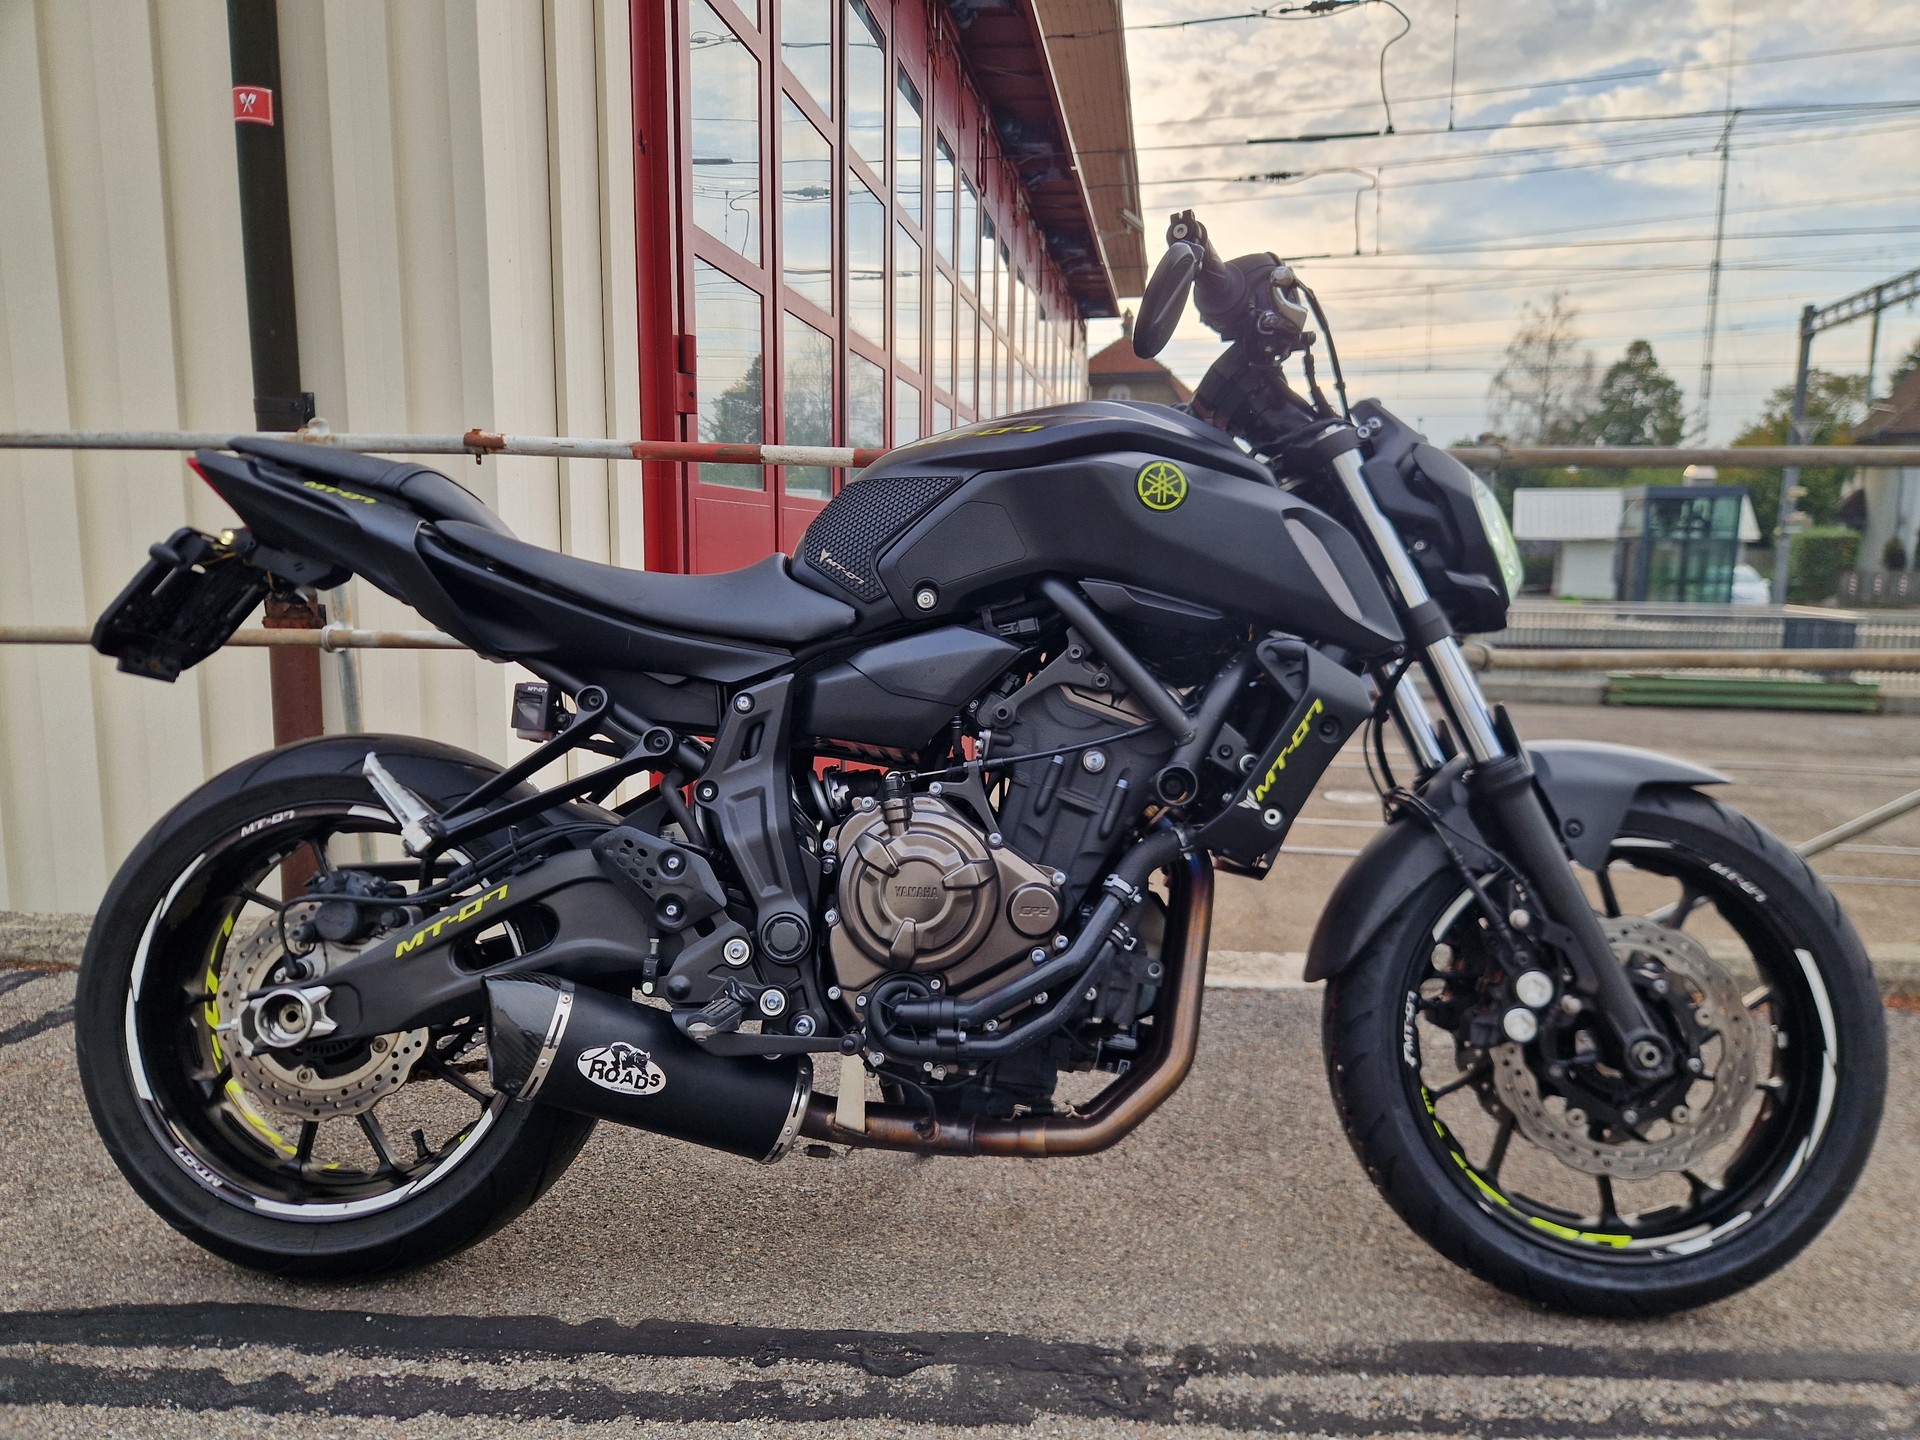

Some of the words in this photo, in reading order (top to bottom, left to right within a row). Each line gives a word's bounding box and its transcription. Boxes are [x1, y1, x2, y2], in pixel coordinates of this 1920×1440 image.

[826, 558, 865, 585] MT-07
[527, 685, 548, 693] MT-07
[1255, 698, 1324, 802] MT-07
[241, 809, 295, 837] MT-07
[894, 885, 939, 899] YAMAHA
[395, 884, 509, 958] MT-07
[1019, 905, 1050, 917] CP2
[1403, 990, 1419, 1051] MT-07
[588, 1059, 661, 1088] ROADS
[174, 1146, 223, 1187] MT-07
